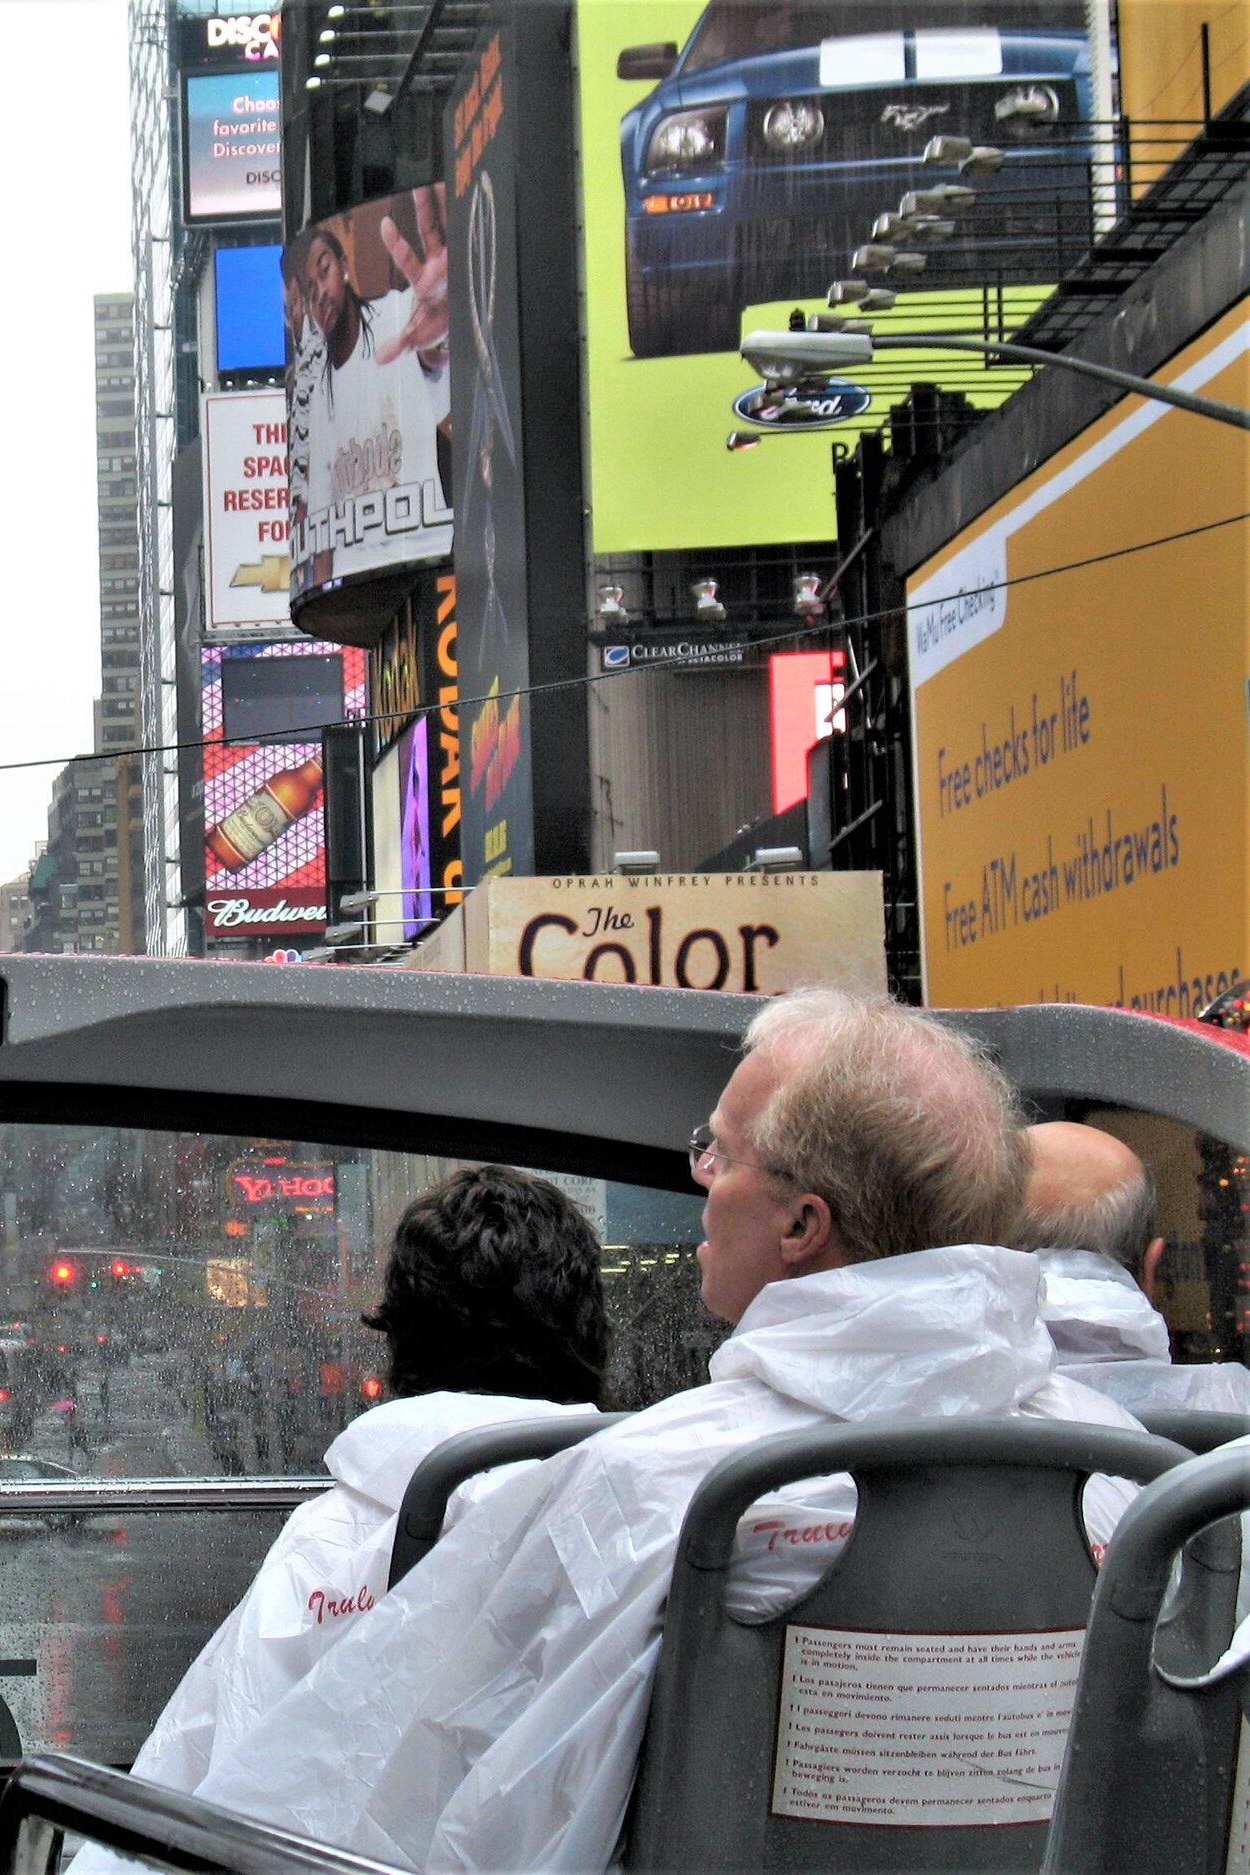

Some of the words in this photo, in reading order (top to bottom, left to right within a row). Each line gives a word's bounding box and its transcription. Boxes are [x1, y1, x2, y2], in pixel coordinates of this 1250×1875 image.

[213, 119, 277, 136] favorite
[938, 747, 971, 818] Free
[975, 705, 1029, 798] checks
[1033, 692, 1057, 768] for
[1061, 669, 1090, 752] life
[944, 882, 978, 953] Free
[981, 852, 1018, 937] ATM
[1022, 835, 1059, 922] cash
[1063, 783, 1180, 902] withdrawals
[553, 877, 614, 889] OPRAH
[629, 876, 712, 888] WINFREY
[726, 875, 819, 887] PRESENTS
[582, 906, 635, 938] The
[519, 906, 780, 992] Color
[802, 1638, 852, 1650] Passengers
[855, 1643, 878, 1651] must
[881, 1644, 913, 1652] remain
[915, 1645, 945, 1653] seated
[949, 1644, 965, 1652] and
[967, 1644, 988, 1653] have
[990, 1644, 1010, 1652] their
[1013, 1643, 1038, 1651] hands
[1040, 1642, 1055, 1650] and
[801, 1649, 851, 1661] completely
[854, 1652, 881, 1662] inside
[884, 1654, 899, 1662] the
[902, 1655, 962, 1664] compartment
[991, 1654, 1014, 1663] times
[1017, 1654, 1038, 1662] while
[1040, 1652, 1053, 1661] the
[811, 1660, 820, 1668] in
[799, 1674, 815, 1684] Los
[818, 1678, 862, 1691] pasajeros
[865, 1682, 894, 1691] tienen
[897, 1684, 914, 1694] que
[916, 1685, 969, 1694] permanecer
[972, 1683, 1010, 1692] sentados
[1012, 1682, 1048, 1691] mientras
[798, 1688, 818, 1696] esta
[821, 1690, 834, 1698] en
[803, 1706, 852, 1720] passeggeri
[854, 1711, 888, 1721] devono
[890, 1712, 931, 1722] rimanere
[934, 1713, 962, 1722] seduti
[964, 1714, 994, 1722] mentre
[795, 1723, 810, 1732] Les
[862, 1730, 896, 1740] doivent
[899, 1732, 927, 1740] rester
[929, 1732, 950, 1741] assis
[952, 1732, 984, 1742] lorsque
[997, 1732, 1012, 1740] bus
[1014, 1730, 1027, 1738] est
[980, 1749, 994, 1758] der
[997, 1749, 1012, 1757] Bus
[792, 1759, 840, 1772] Passagiers
[844, 1764, 878, 1775] worden
[882, 1767, 921, 1777] verzocht
[924, 1769, 934, 1777] te
[936, 1769, 966, 1778] blijven
[1025, 1766, 1035, 1774] de
[1037, 1764, 1051, 1772] bus
[791, 1769, 835, 1784] beweging
[789, 1800, 821, 1809] estiver
[824, 1803, 839, 1811] em
[821, 1792, 832, 1800] os
[889, 1796, 919, 1805] devem
[921, 1798, 974, 1807] permanecer
[977, 1796, 1014, 1804] sentados
